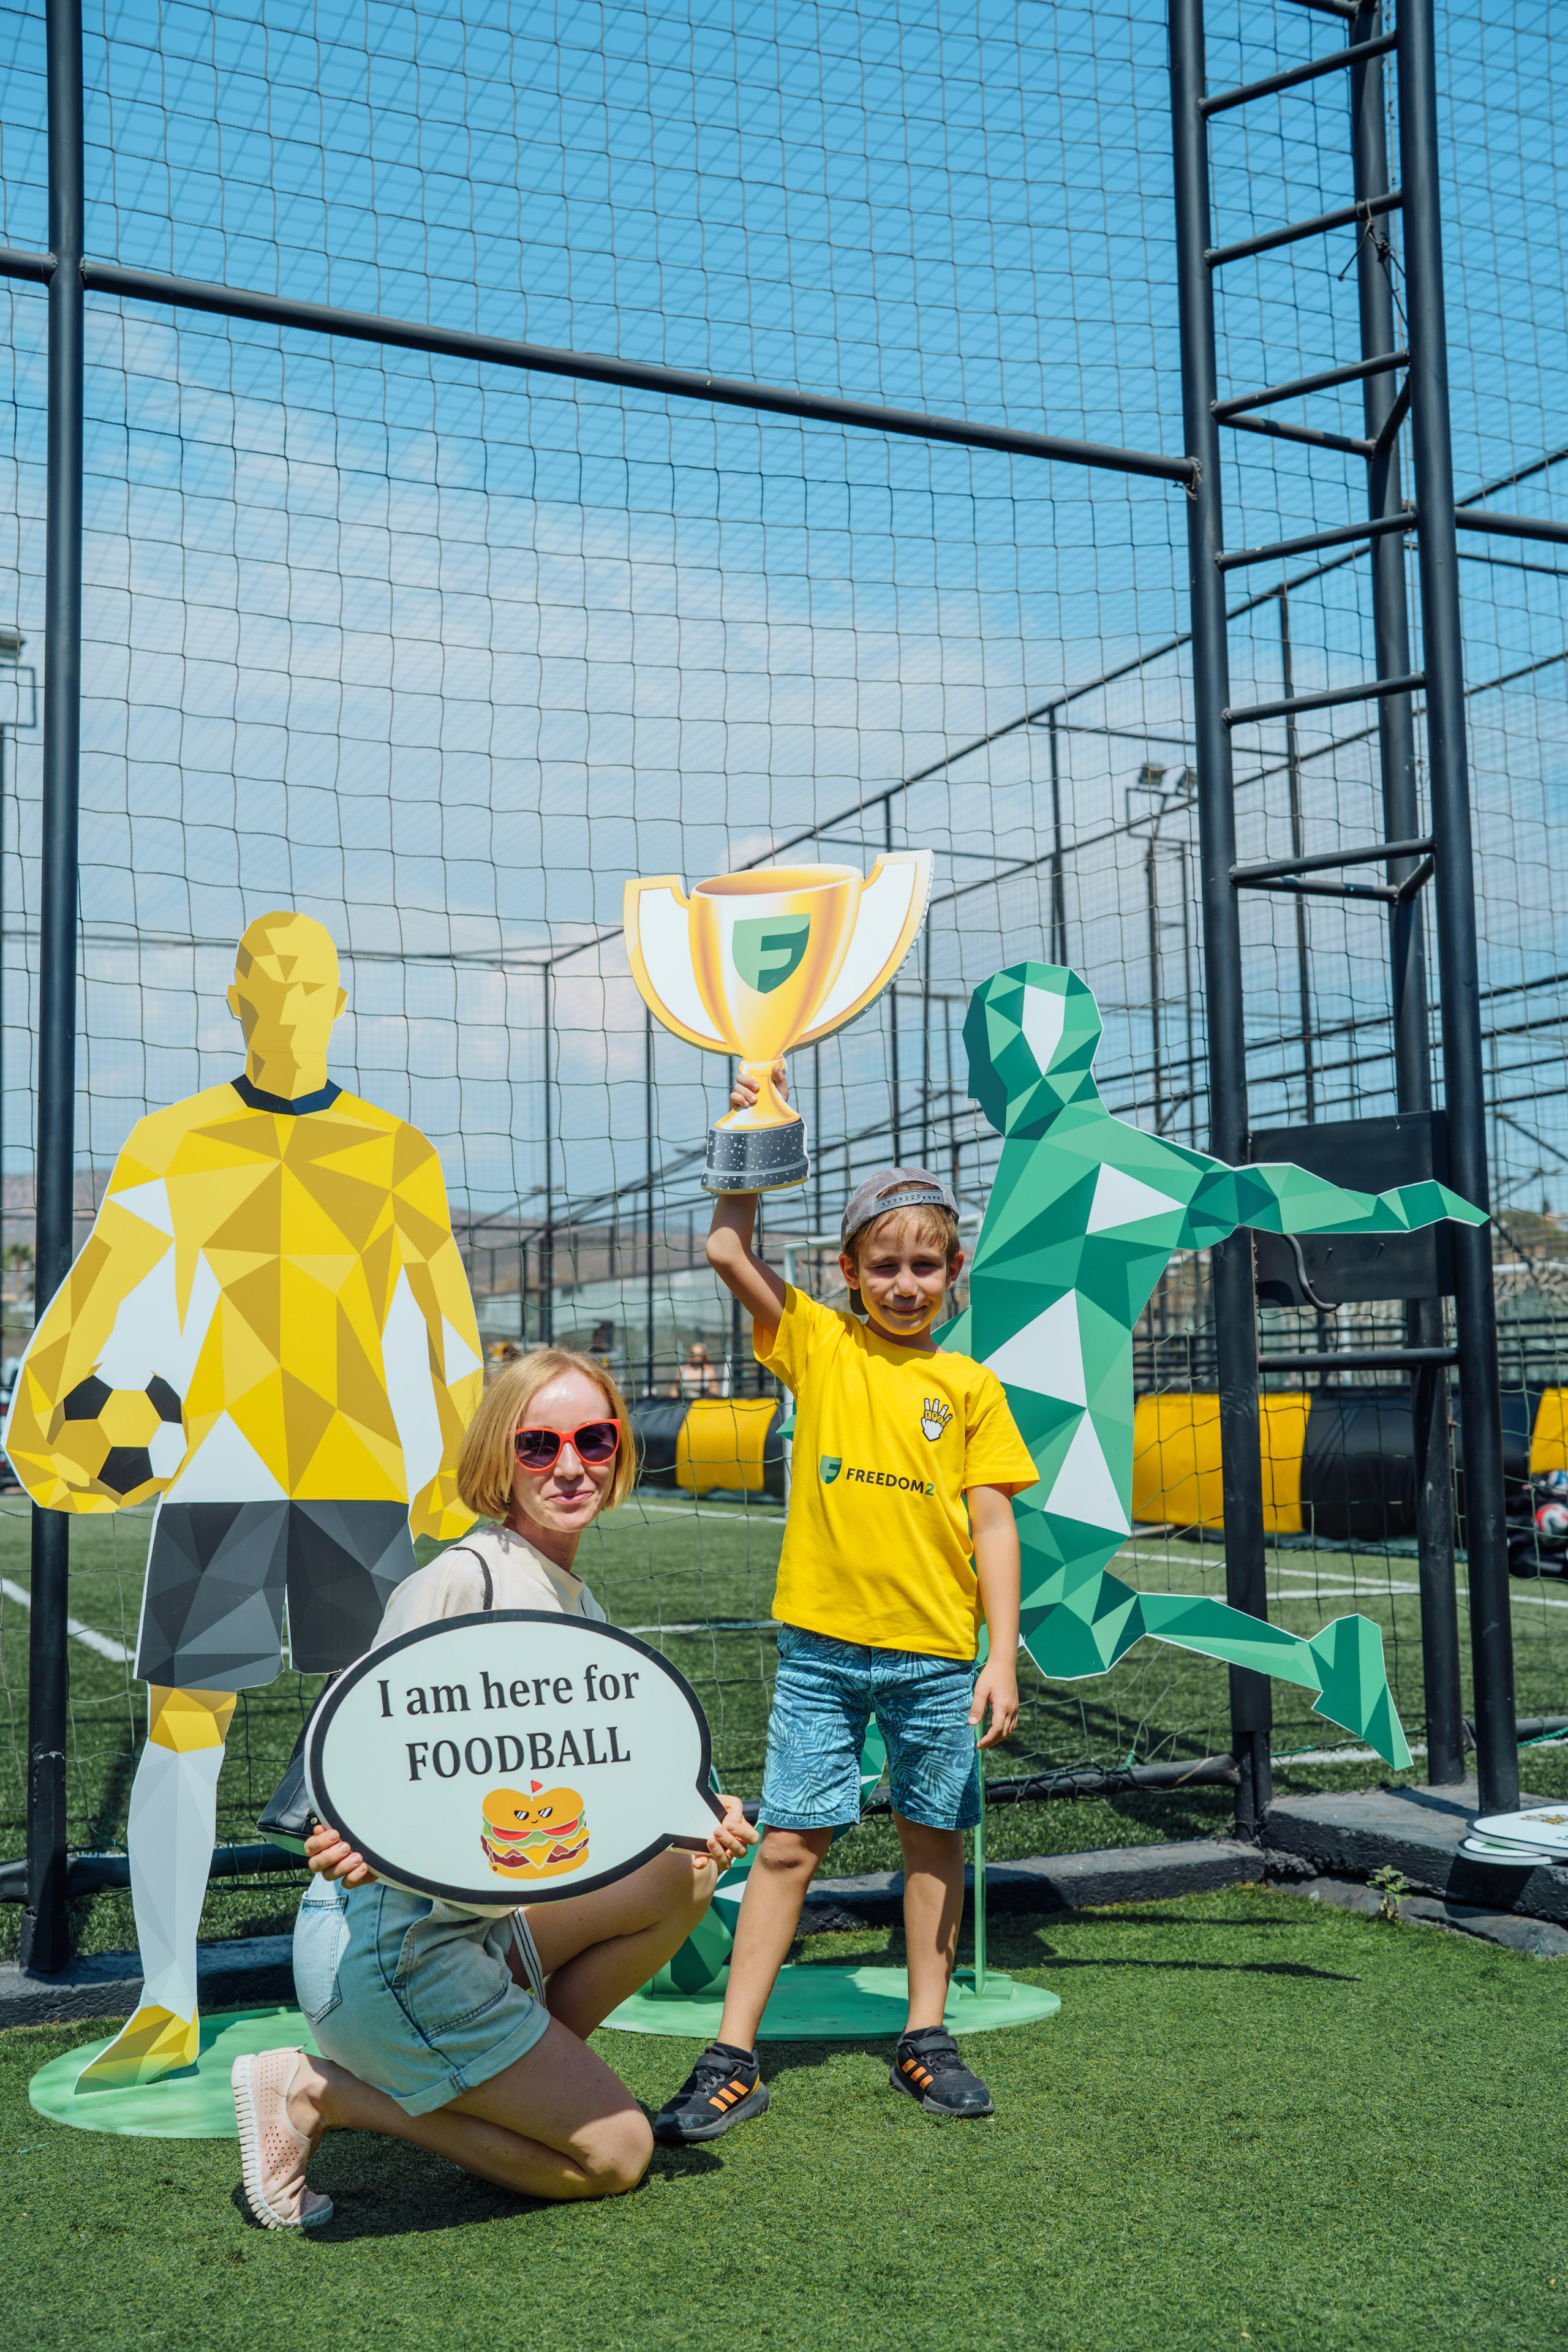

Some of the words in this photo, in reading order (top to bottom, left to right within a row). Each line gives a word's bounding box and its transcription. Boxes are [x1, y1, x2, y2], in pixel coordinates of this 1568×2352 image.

[377, 1679, 394, 1717] I
[406, 1684, 471, 1716] am
[479, 1671, 573, 1709] here
[583, 1664, 639, 1702] for
[405, 1726, 631, 1781] FOODBALL
